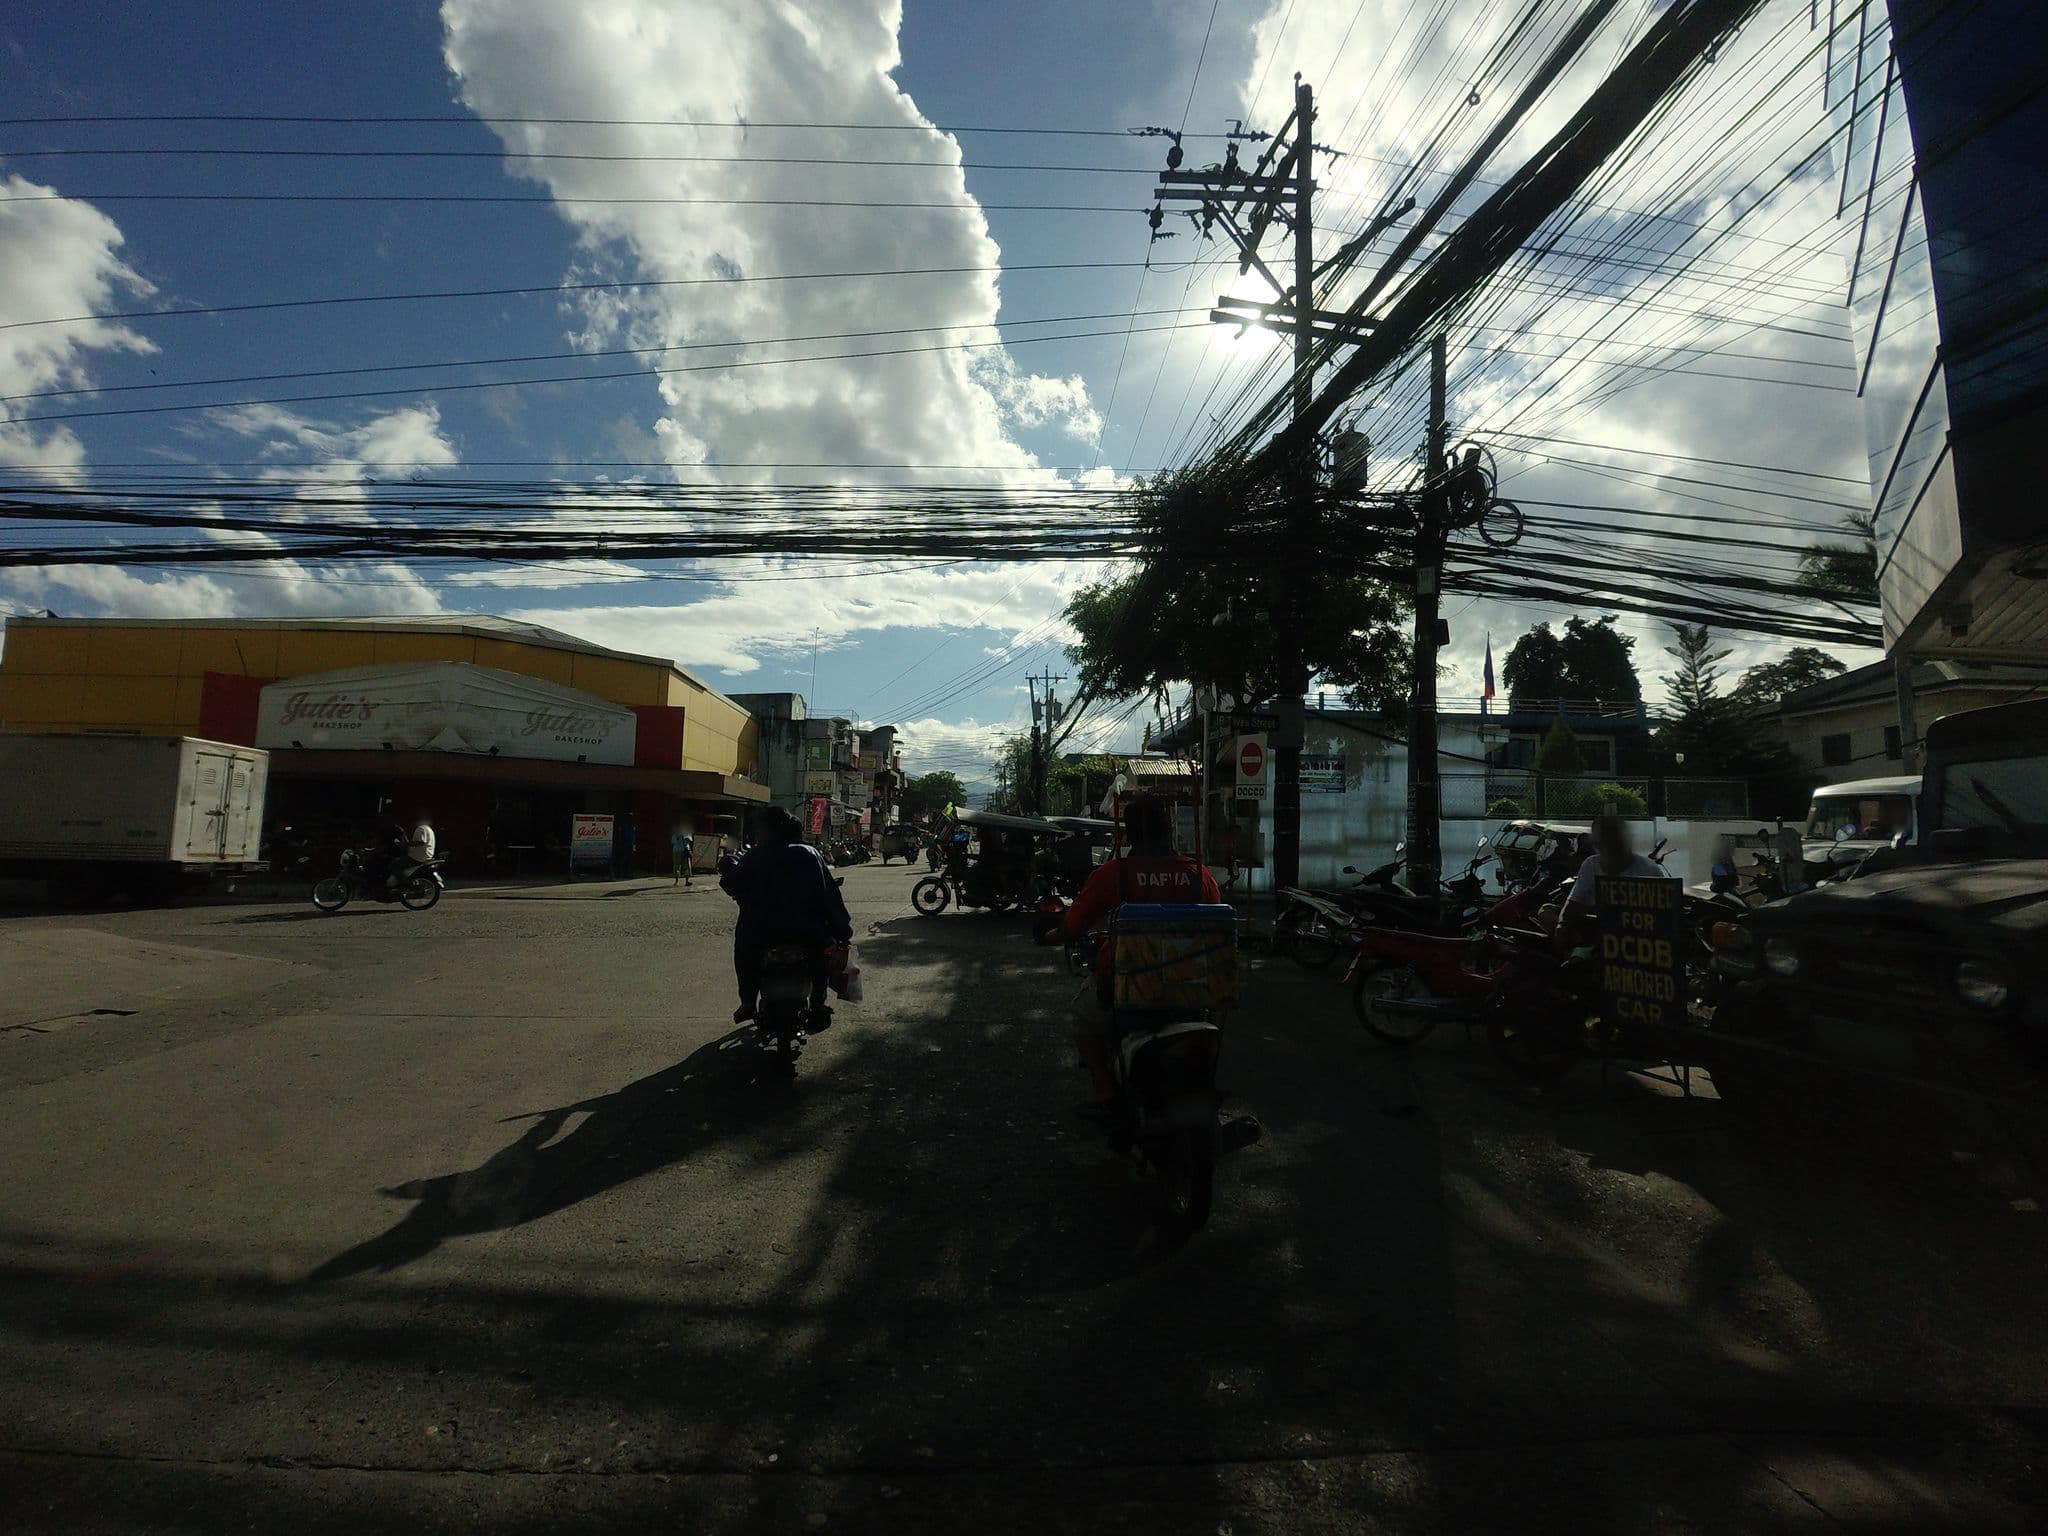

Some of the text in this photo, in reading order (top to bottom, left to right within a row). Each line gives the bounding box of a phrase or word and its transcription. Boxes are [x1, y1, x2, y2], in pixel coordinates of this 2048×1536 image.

[279, 692, 378, 726] Julie's
[312, 722, 362, 730] BAKESHOP
[554, 735, 603, 746] BAKESHOP
[1620, 911, 1655, 931] FOR
[1602, 932, 1673, 969] DCDB
[1603, 964, 1675, 1003] ARMORED
[1616, 996, 1663, 1025] CAR
